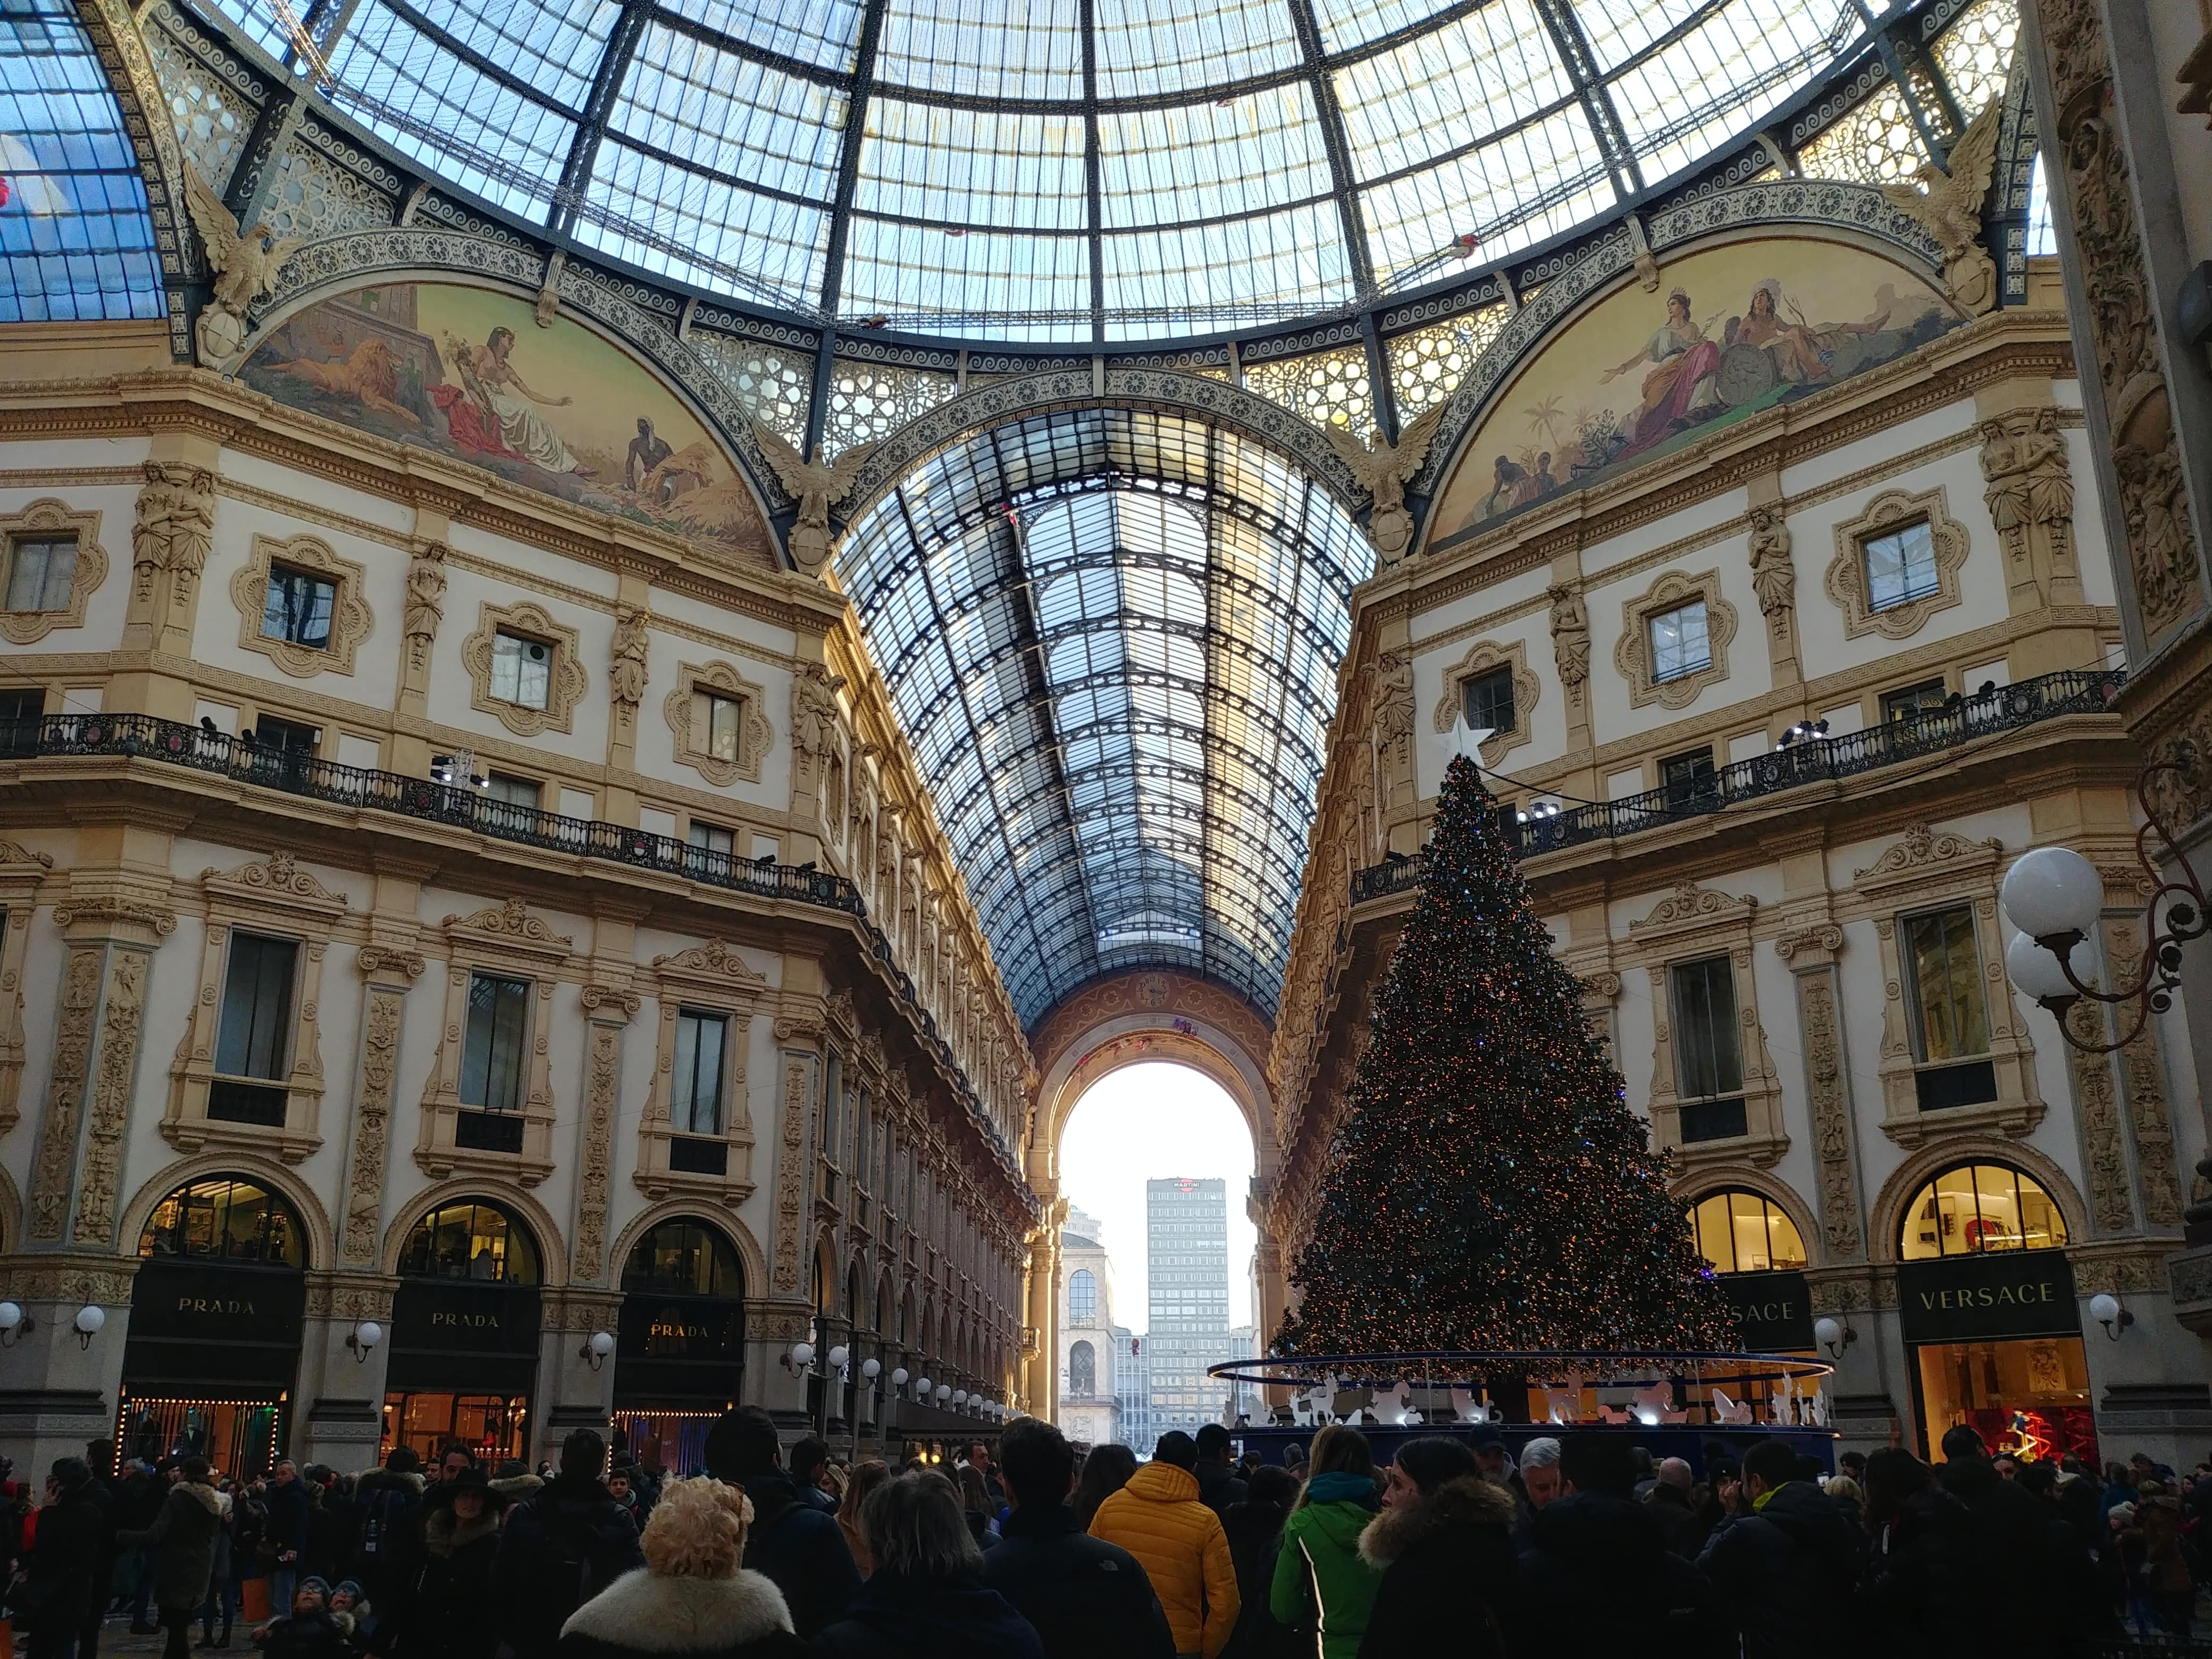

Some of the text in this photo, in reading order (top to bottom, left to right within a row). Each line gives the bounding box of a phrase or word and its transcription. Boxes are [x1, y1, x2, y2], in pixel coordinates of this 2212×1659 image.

[1920, 1282, 2056, 1311] VERSACE
[178, 1297, 256, 1314] PRADA
[1730, 1301, 1795, 1324] SACE
[432, 1312, 499, 1328] PRADA
[650, 1323, 709, 1338] PRADA
